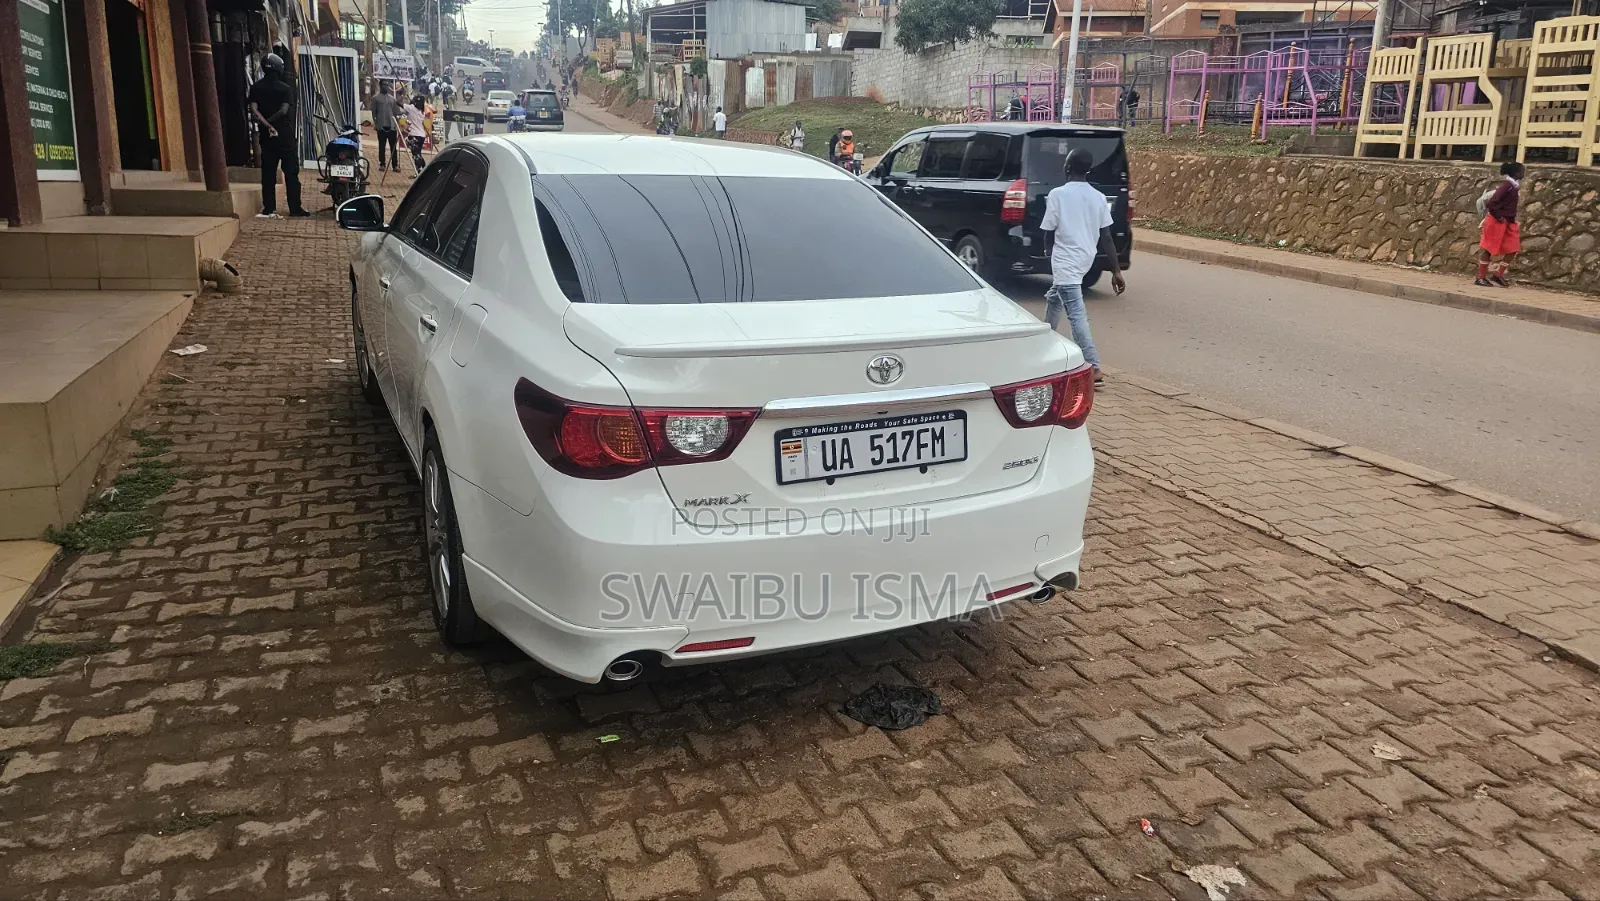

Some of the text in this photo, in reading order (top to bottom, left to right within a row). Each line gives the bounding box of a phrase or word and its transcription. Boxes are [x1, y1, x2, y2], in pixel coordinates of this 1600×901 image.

[811, 425, 838, 434] Making
[855, 421, 878, 430] Roads
[884, 419, 900, 427] Your
[903, 417, 918, 425] Safe
[920, 414, 940, 423] Space
[821, 425, 946, 472] UA 517FM
[683, 491, 753, 507] MARK X
